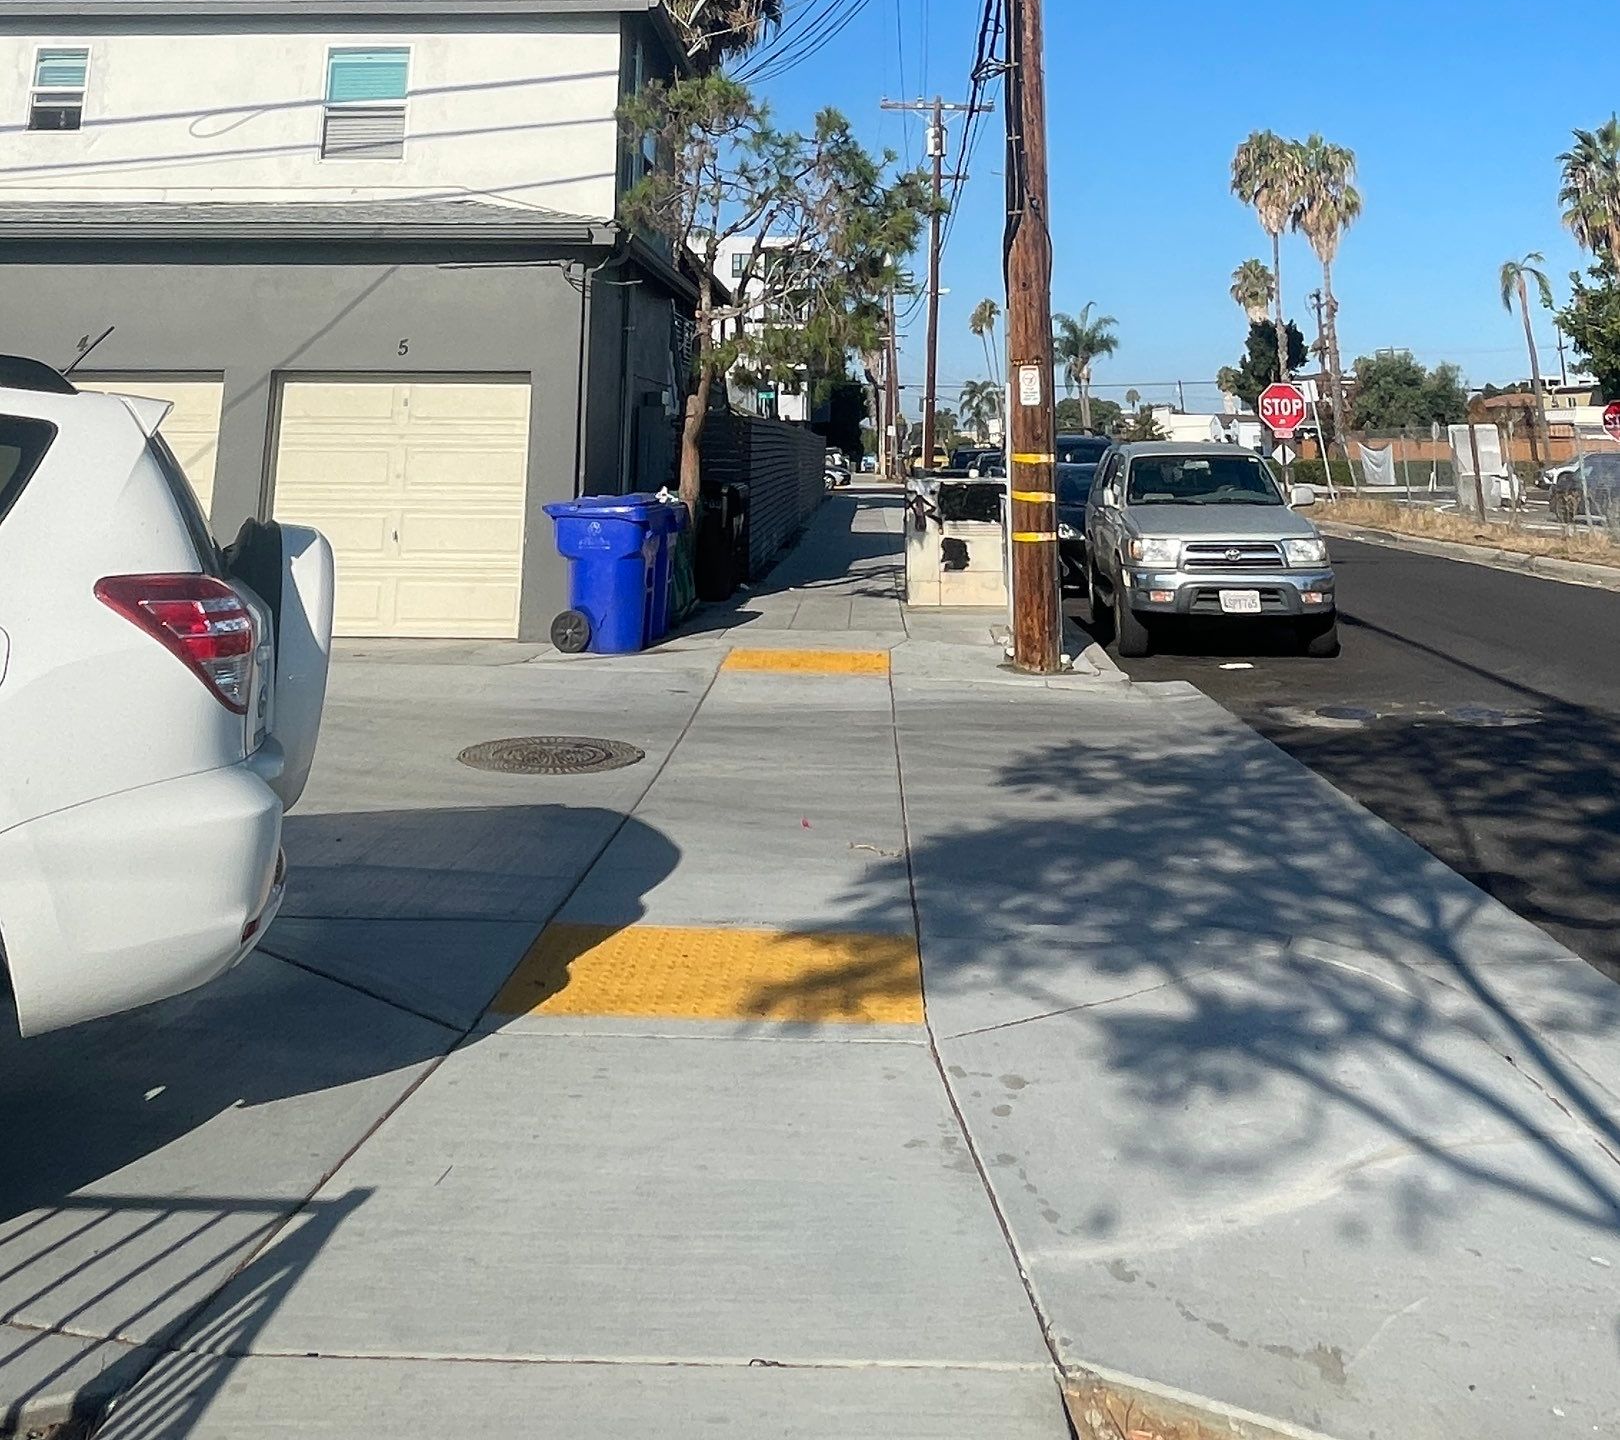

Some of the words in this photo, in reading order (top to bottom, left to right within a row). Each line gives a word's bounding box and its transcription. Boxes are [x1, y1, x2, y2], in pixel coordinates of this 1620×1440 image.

[77, 335, 89, 351] 4
[398, 339, 409, 356] 5
[1263, 398, 1302, 416] STOP
